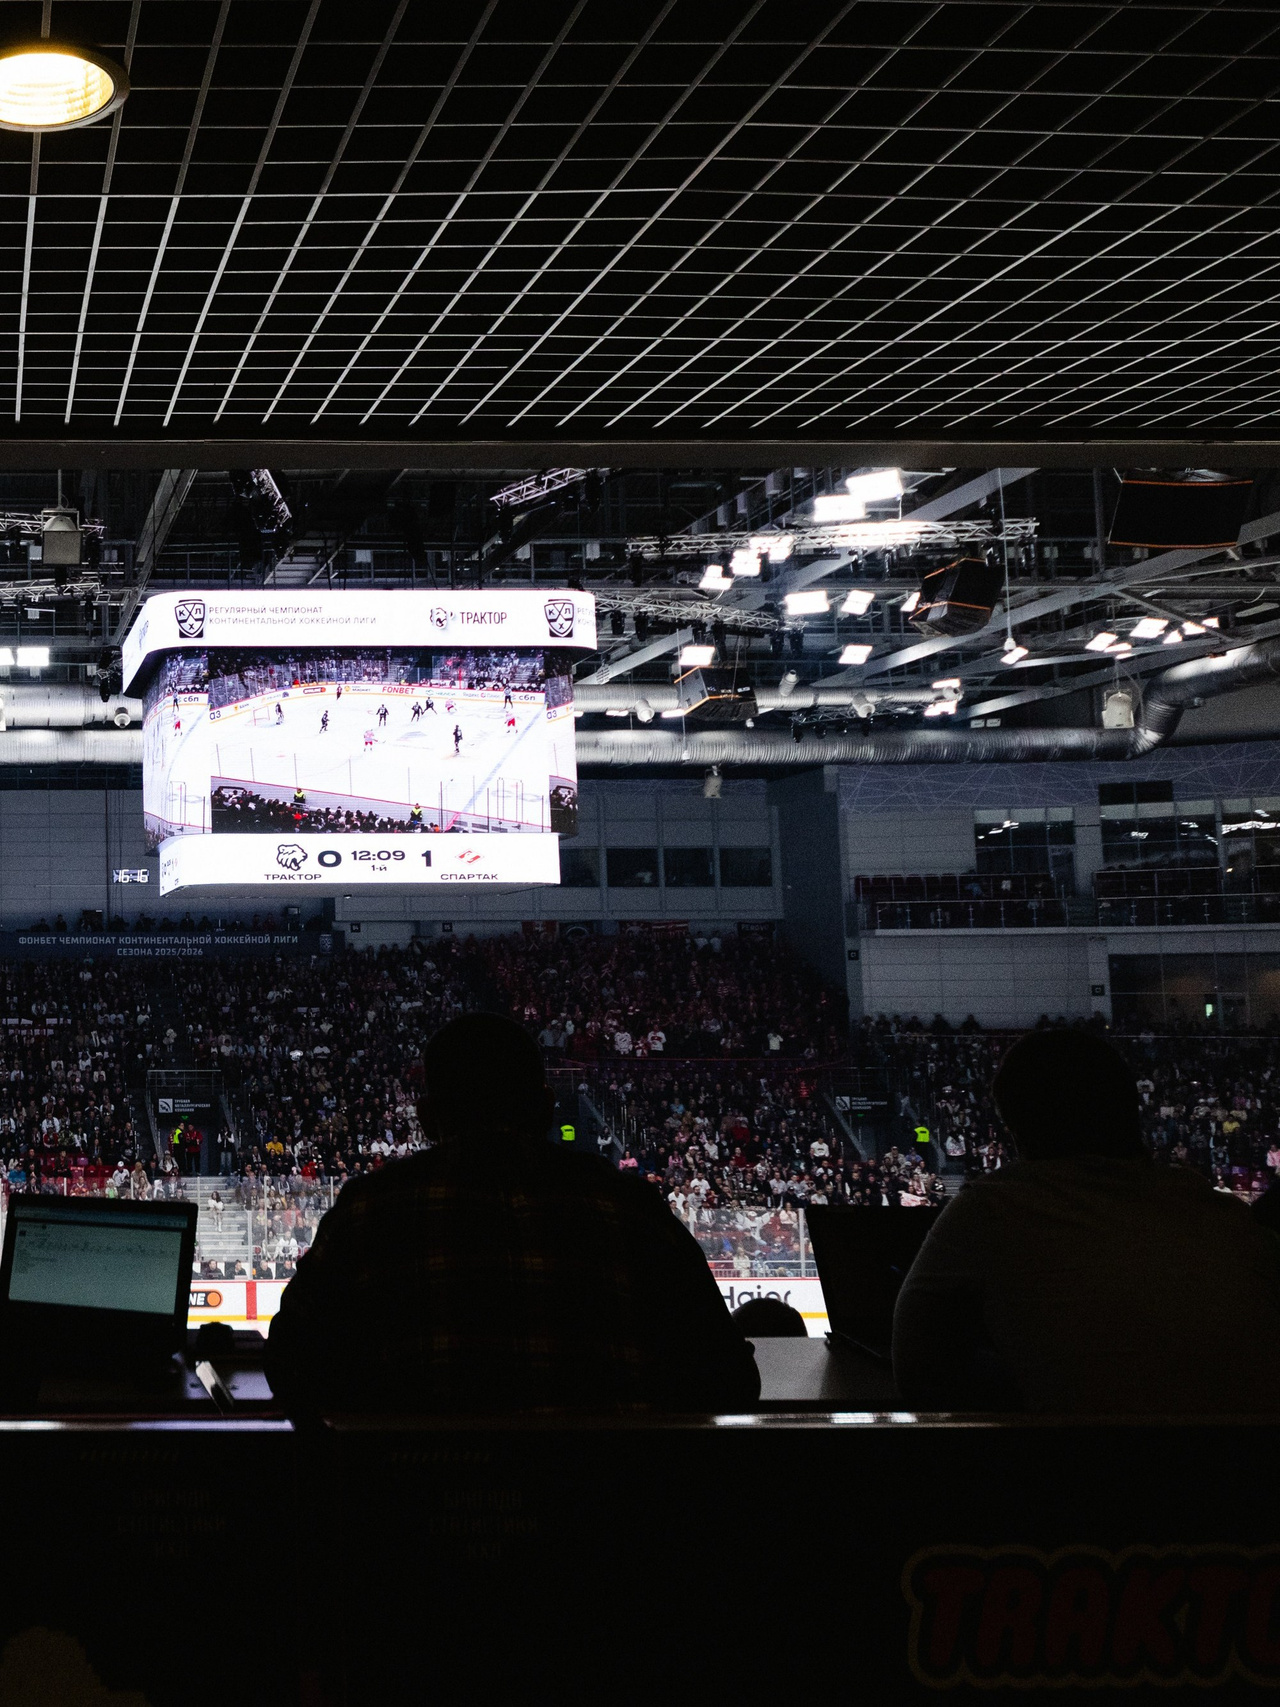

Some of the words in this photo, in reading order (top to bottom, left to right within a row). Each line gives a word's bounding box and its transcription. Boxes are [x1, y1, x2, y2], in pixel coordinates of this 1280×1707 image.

[208, 604, 267, 614] РЕГУЛЯРНЫЙ
[269, 605, 323, 614] ЧЕМПИОНАТ
[208, 615, 296, 625] КОНТИНЕНТАЛЬНОЙ
[298, 615, 351, 625] ХОККЕЙНОЙ
[353, 616, 377, 625] ЛИГИ
[459, 611, 507, 624] ТРАКТОР
[382, 686, 416, 695] FONBET
[317, 850, 342, 867] 0
[351, 850, 406, 861] 12:09
[421, 850, 432, 867] 1
[118, 869, 148, 883] 16:16
[264, 873, 322, 881] ТРАКТОР
[440, 873, 499, 881] СПАРТАК
[18, 936, 57, 945] ФОНБЕТ
[59, 935, 116, 945] ЧЕМПИОНАТ
[119, 935, 211, 945] КОНТИНЕНТАЛЬНОЙ
[214, 934, 271, 944] ХОККЕЙНОЙ
[273, 935, 298, 944] ЛИГИ
[116, 947, 153, 957] СЕЗОНА
[155, 947, 204, 957] 2025/2026
